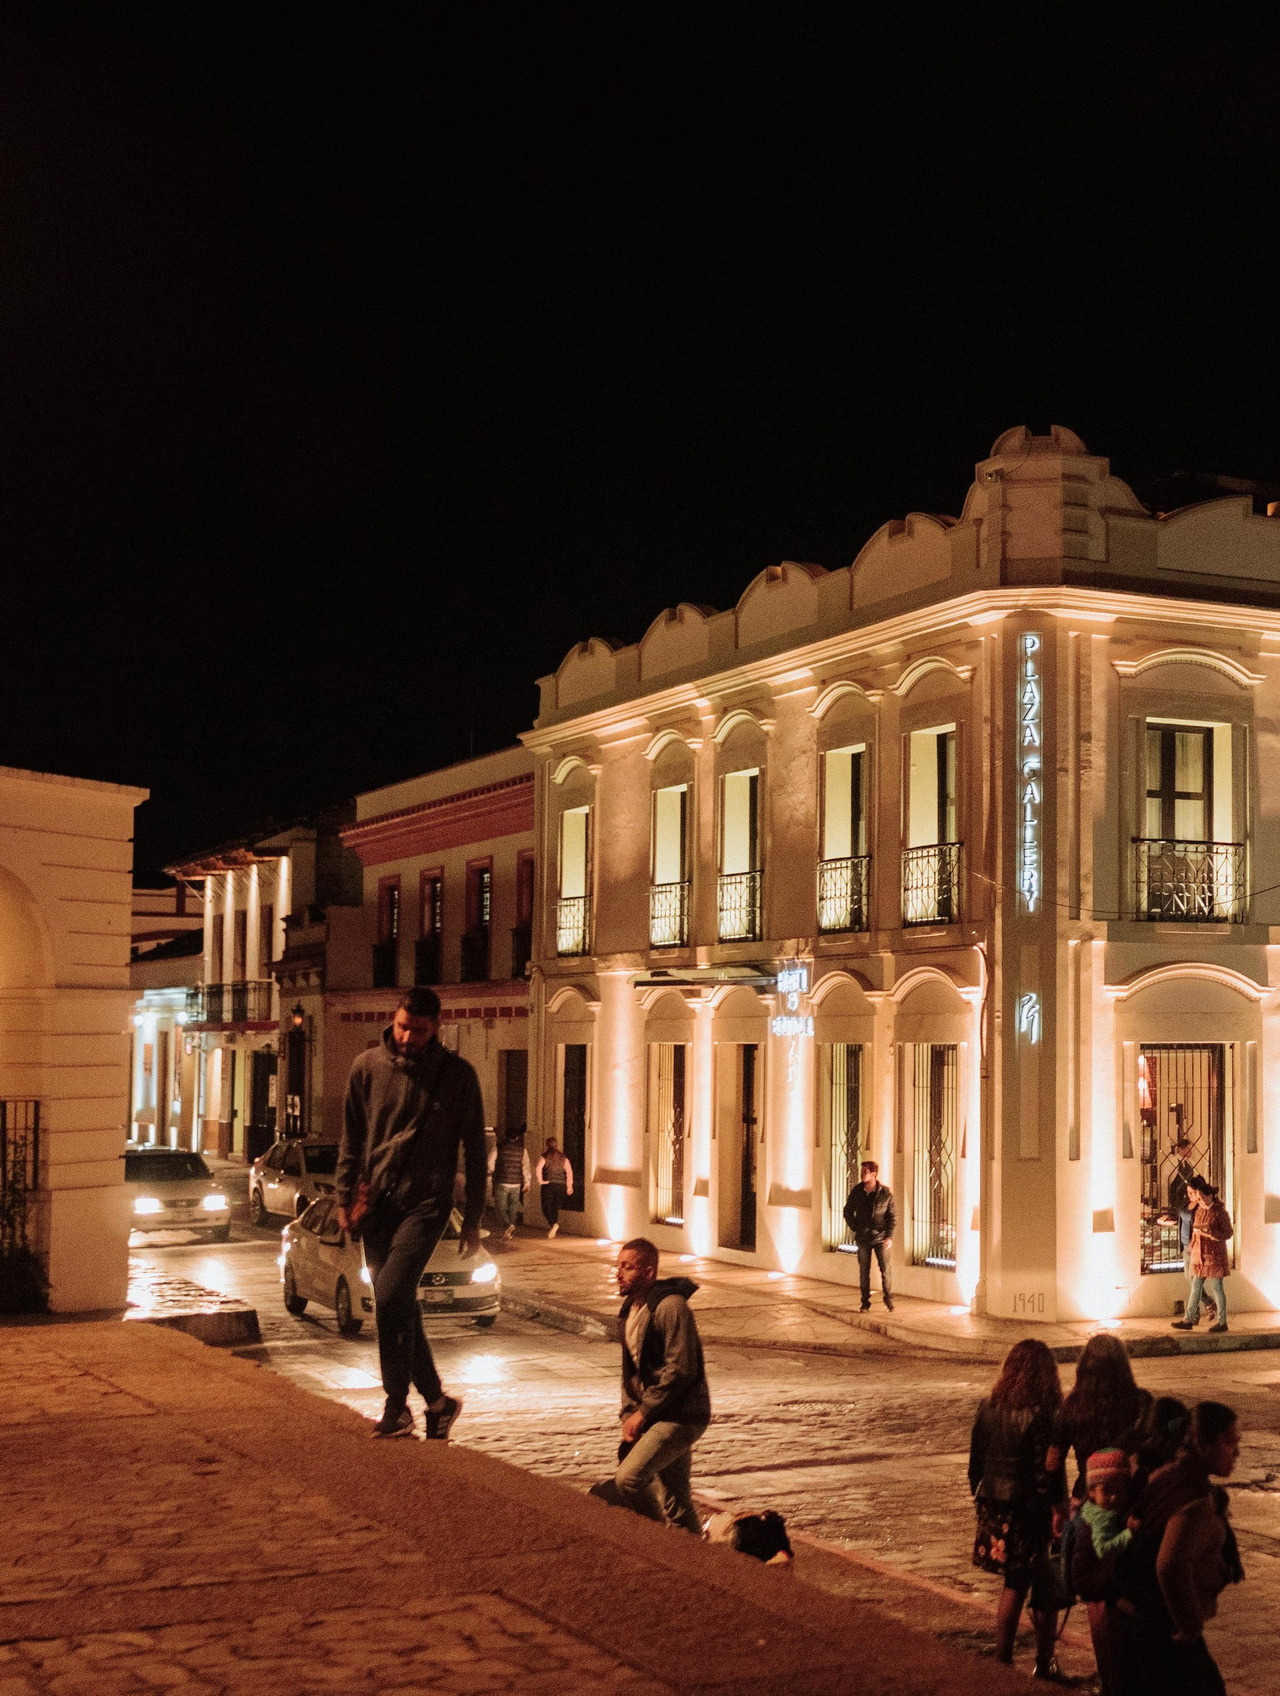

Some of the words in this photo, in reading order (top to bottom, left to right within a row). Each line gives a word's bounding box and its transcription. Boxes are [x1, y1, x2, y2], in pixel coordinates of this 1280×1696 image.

[1021, 635, 1039, 745] PLAZA
[1021, 757, 1040, 912] GALLERY
[1013, 1293, 1045, 1313] 1940
